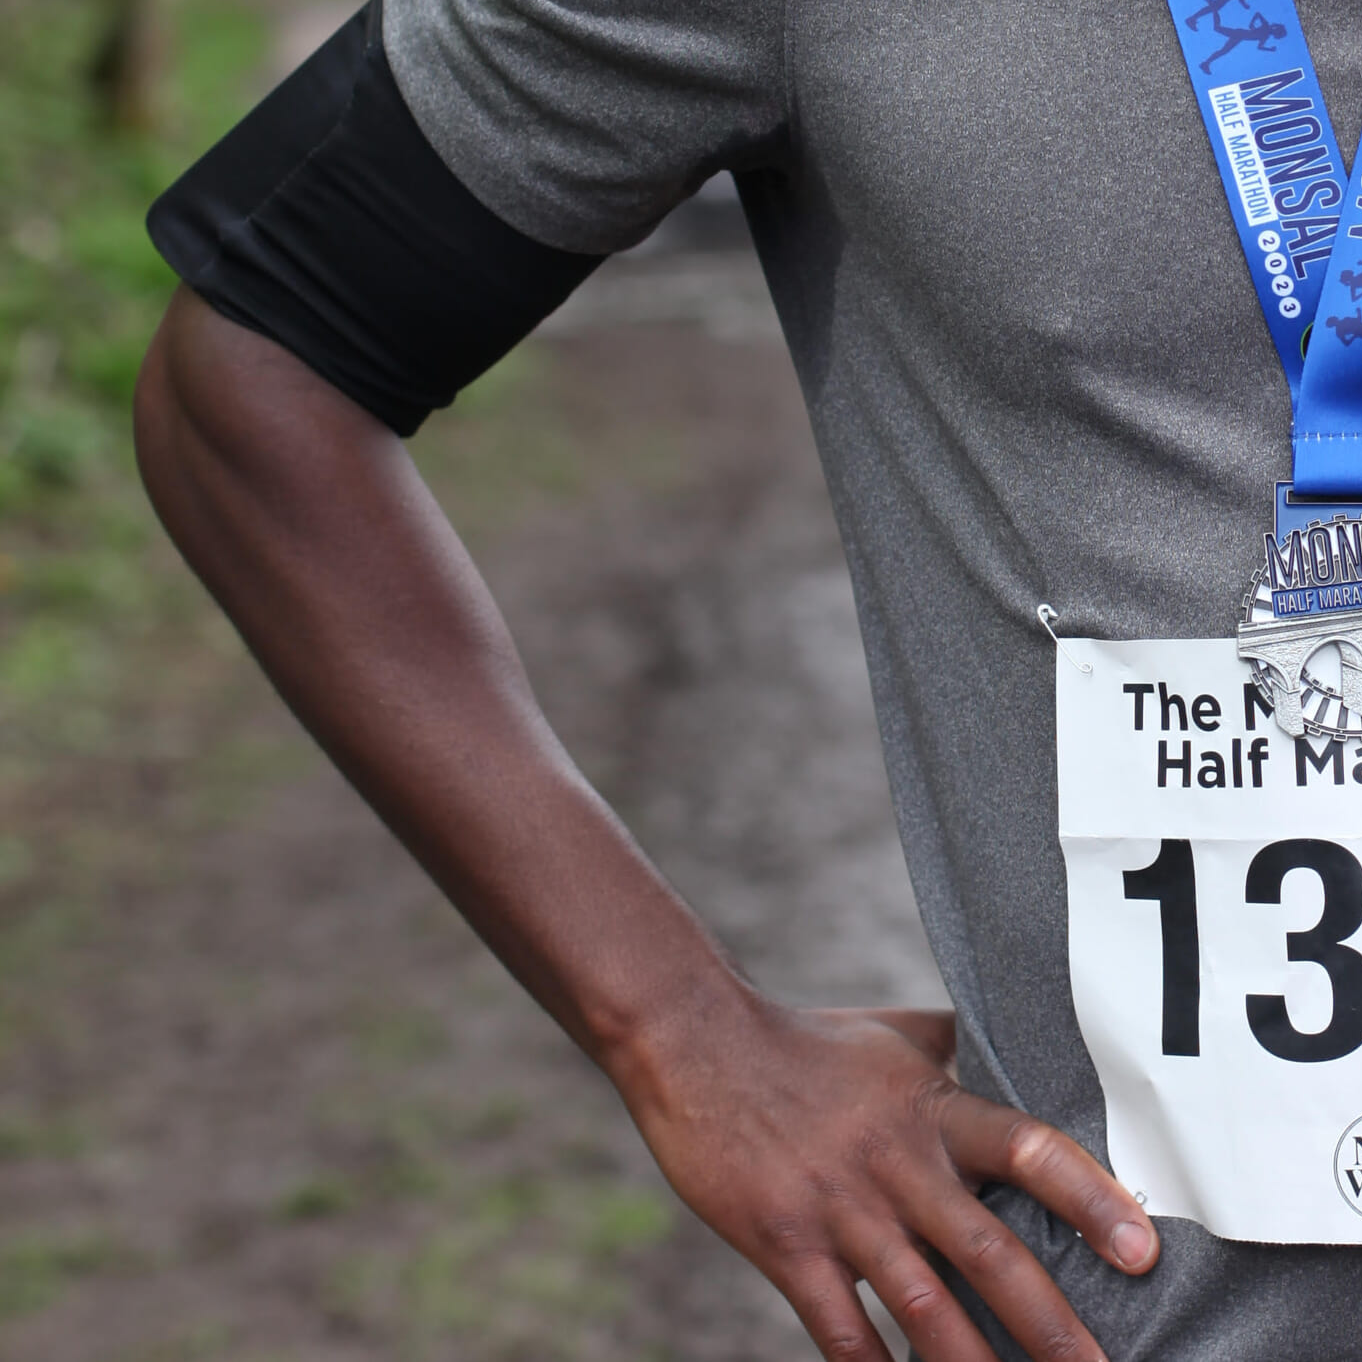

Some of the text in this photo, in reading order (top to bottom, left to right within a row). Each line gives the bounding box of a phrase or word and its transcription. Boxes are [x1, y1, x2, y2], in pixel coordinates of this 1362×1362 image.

[1214, 91, 1273, 220] HALF MARATHON
[1239, 67, 1342, 280] MONSAL
[1259, 232, 1300, 316] 2023
[1276, 592, 1313, 614] HALF
[1122, 681, 1222, 732] The
[1157, 737, 1269, 789] Half
